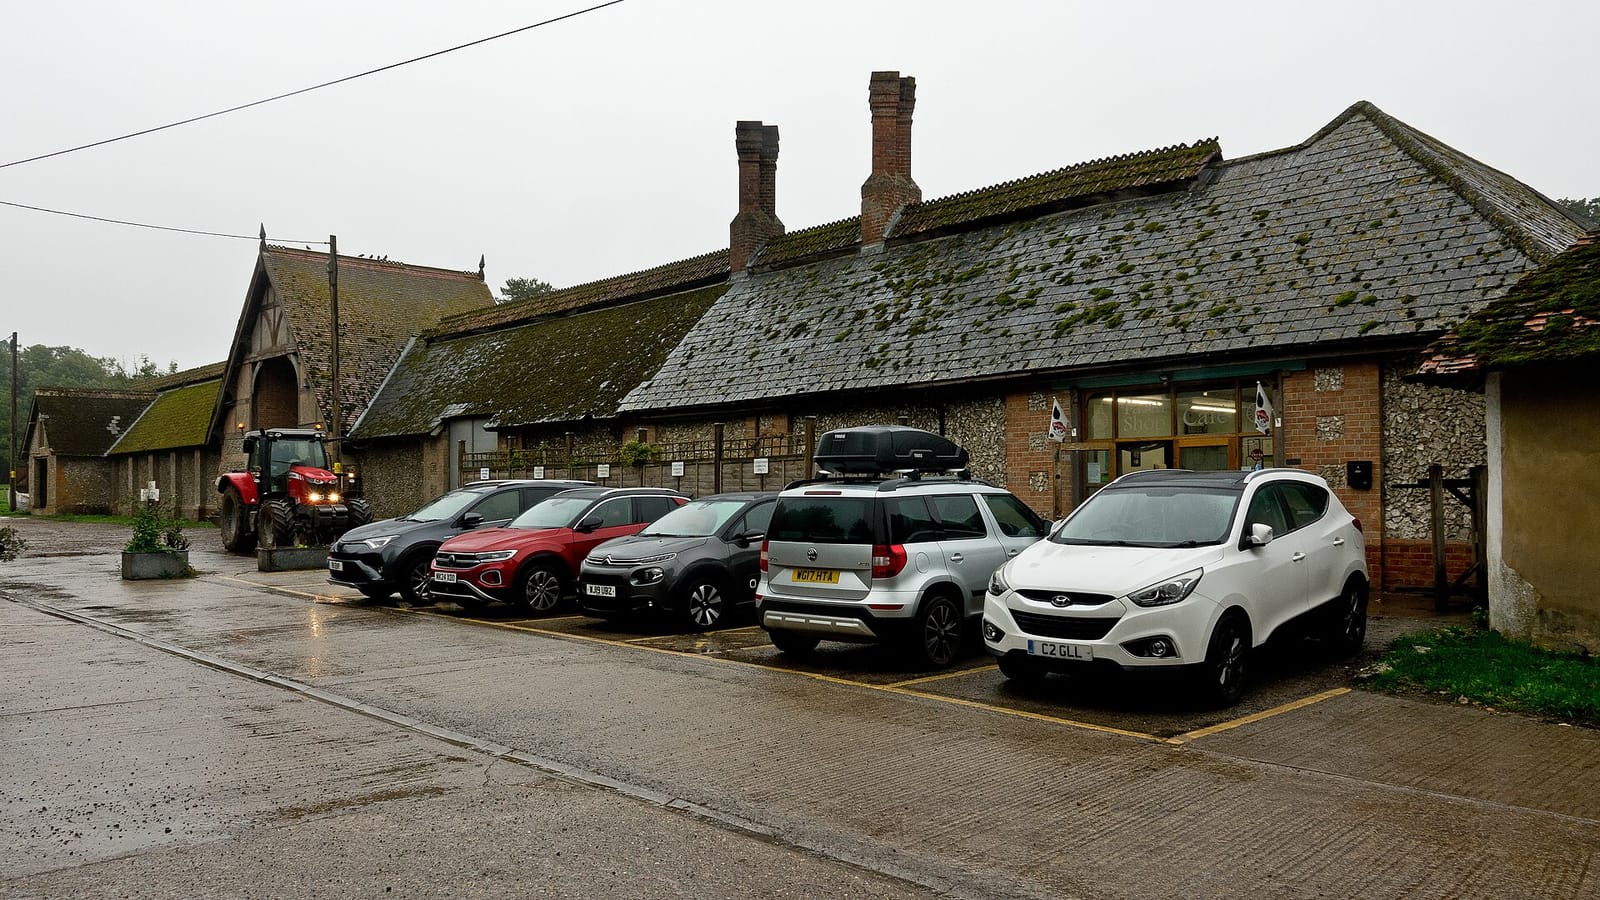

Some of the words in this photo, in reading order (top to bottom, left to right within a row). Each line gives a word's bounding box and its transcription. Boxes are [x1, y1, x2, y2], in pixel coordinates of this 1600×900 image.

[797, 569, 815, 580] WG17
[816, 571, 833, 582] HTA
[1041, 643, 1056, 656] C2
[1059, 645, 1082, 659] GLL
